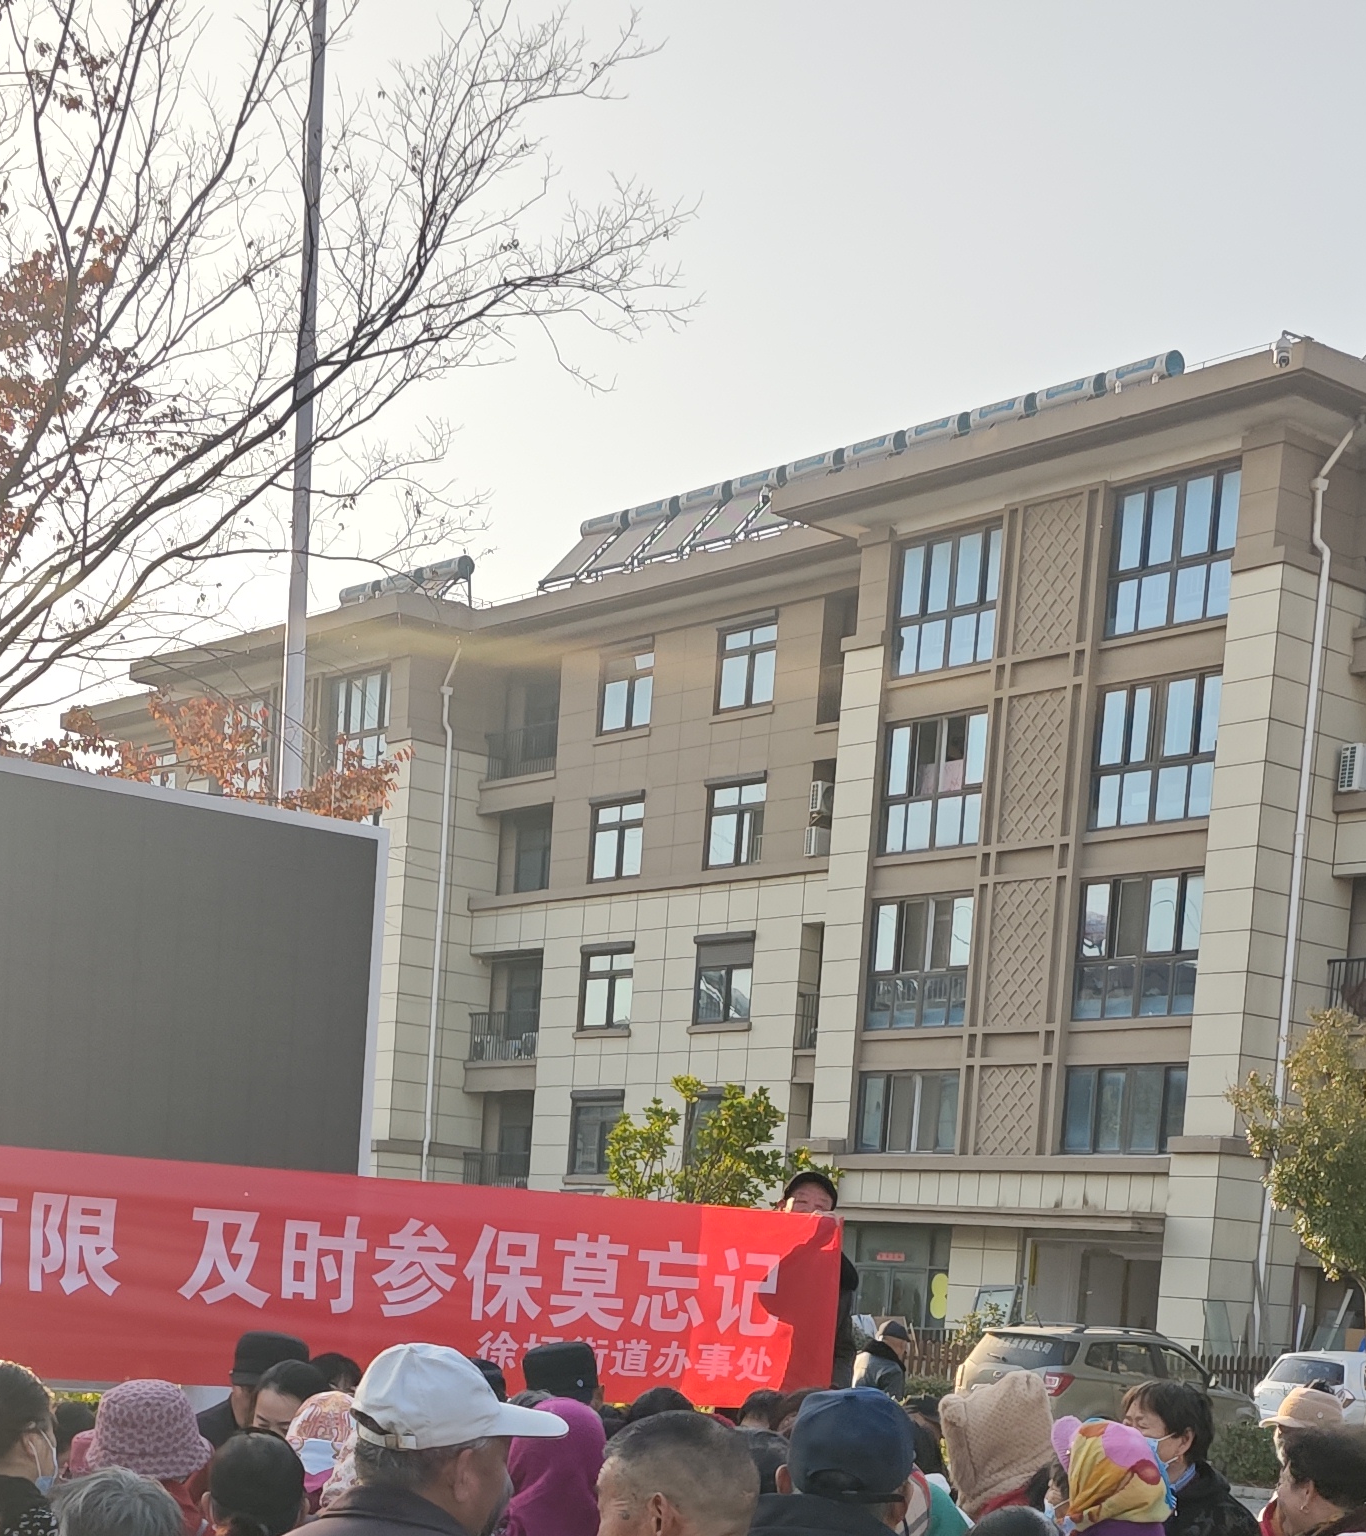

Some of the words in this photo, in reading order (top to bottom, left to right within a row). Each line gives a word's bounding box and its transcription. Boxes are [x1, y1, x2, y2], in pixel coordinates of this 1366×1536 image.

[178, 1205, 780, 1336] 及时参保莫忘记
[476, 1331, 773, 1383] 徐道办事处
